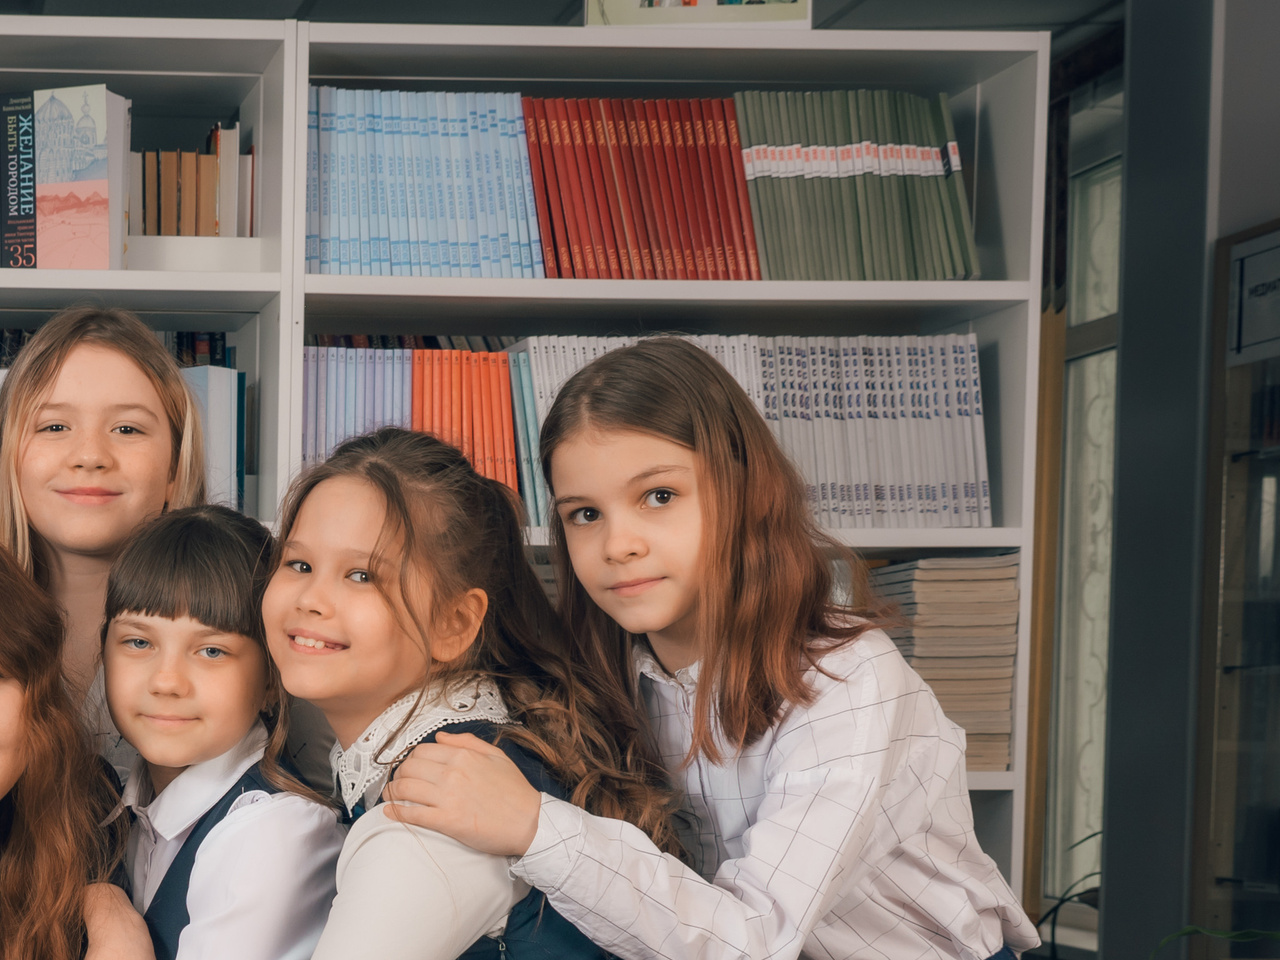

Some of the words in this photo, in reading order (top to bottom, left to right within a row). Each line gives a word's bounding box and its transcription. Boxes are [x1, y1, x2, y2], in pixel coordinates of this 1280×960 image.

[7, 115, 17, 152] БЫТЬ
[7, 154, 18, 216] ГОРОДОМ
[18, 114, 34, 216] ЖЕЛАНИЕ
[9, 244, 35, 268] 35
